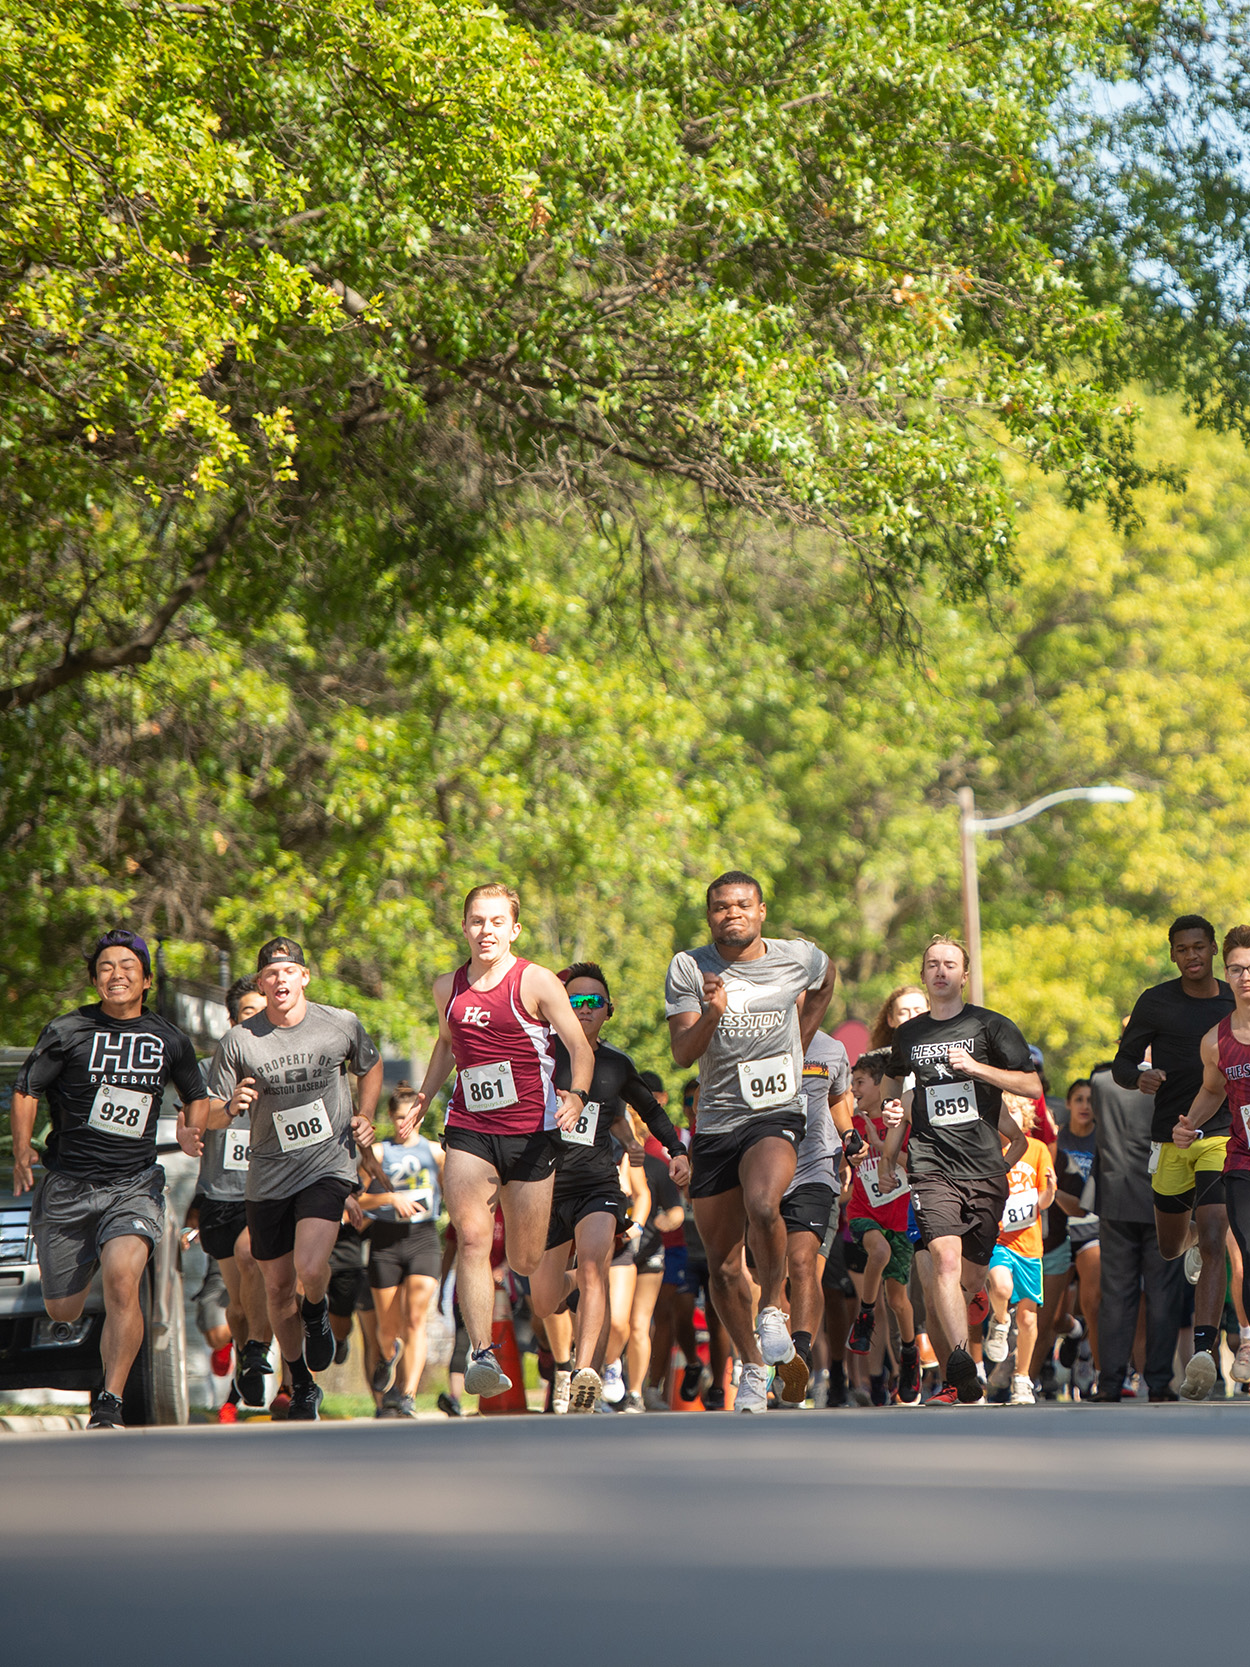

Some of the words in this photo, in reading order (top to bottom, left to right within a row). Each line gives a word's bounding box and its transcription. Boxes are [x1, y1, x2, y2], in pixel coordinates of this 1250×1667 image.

[461, 1006, 491, 1027] HC
[718, 1010, 787, 1029] ESSTON
[721, 1028, 768, 1037] SOCCER
[88, 1032, 164, 1073] HC
[911, 1038, 974, 1060] HESSTON
[256, 1053, 314, 1078] PROPERTY
[318, 1055, 333, 1067] OF
[918, 1057, 949, 1066] COLLE
[90, 1074, 161, 1085] BASEBALL
[270, 1074, 280, 1084] 20
[312, 1068, 322, 1077] 22
[297, 1079, 329, 1093] BASEBALL
[750, 1073, 787, 1098] 943
[470, 1079, 505, 1102] 861
[468, 1097, 516, 1110] timerguys.com
[934, 1096, 970, 1117] 859
[99, 1102, 141, 1127] 928
[284, 1117, 323, 1141] 908
[1008, 1204, 1034, 1223] 817
